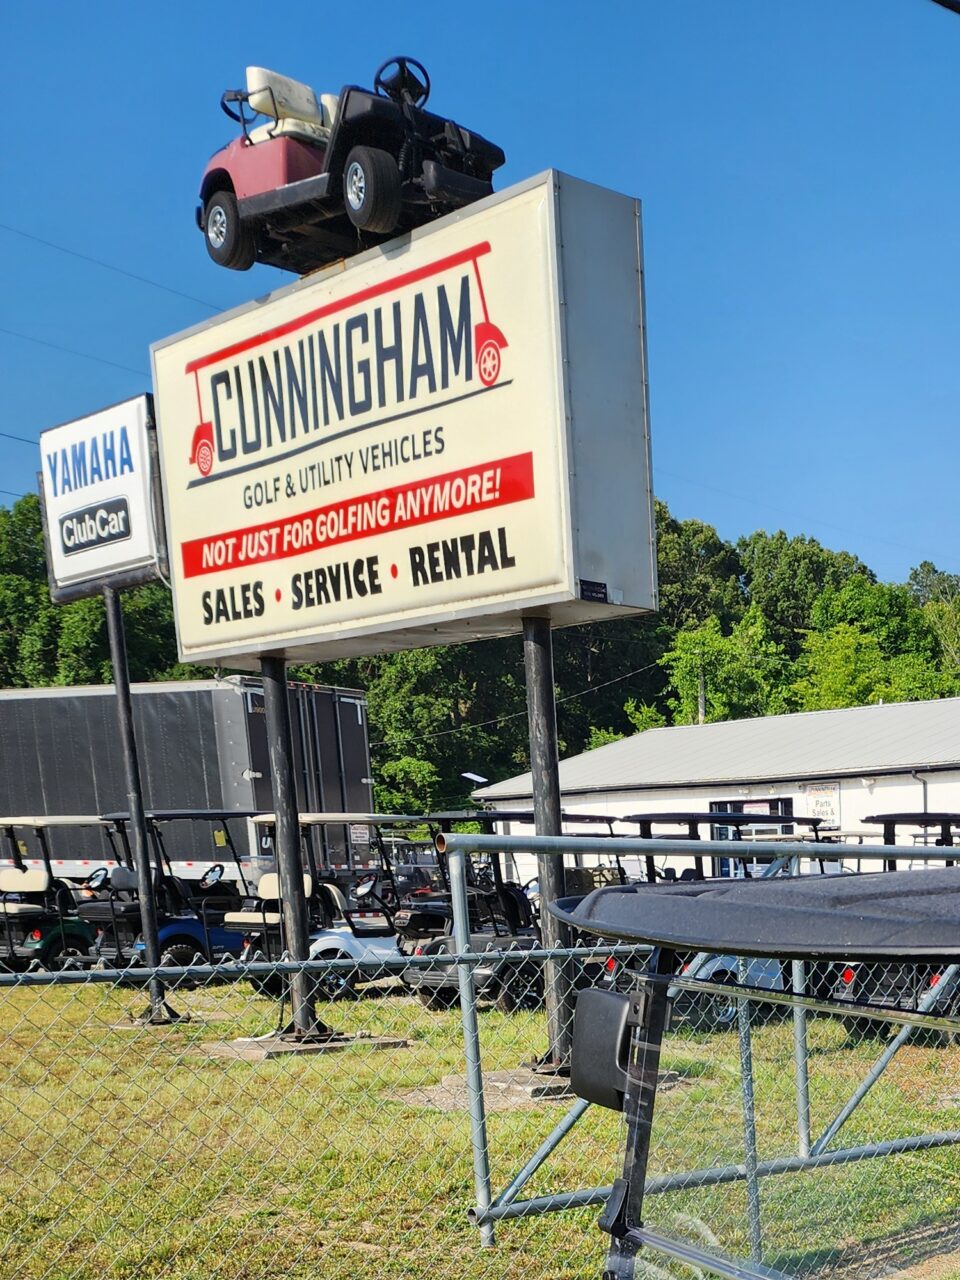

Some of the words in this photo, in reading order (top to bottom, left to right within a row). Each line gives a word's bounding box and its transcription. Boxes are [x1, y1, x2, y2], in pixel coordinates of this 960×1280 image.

[210, 274, 473, 462] CUNNINGHAM
[47, 425, 134, 497] YAMAHA
[243, 476, 280, 509] GOLF
[285, 473, 296, 497] &
[299, 452, 354, 494] UTILITY
[359, 426, 445, 474] VEHICLES
[202, 538, 237, 568] NOT
[238, 527, 280, 561] JUST
[283, 522, 312, 550] FOR
[316, 498, 390, 540] GOLFING
[394, 468, 502, 523] ANYMORE!
[202, 581, 265, 625] SALES
[291, 555, 383, 611] SERVICE
[408, 526, 516, 587] RENTAL
